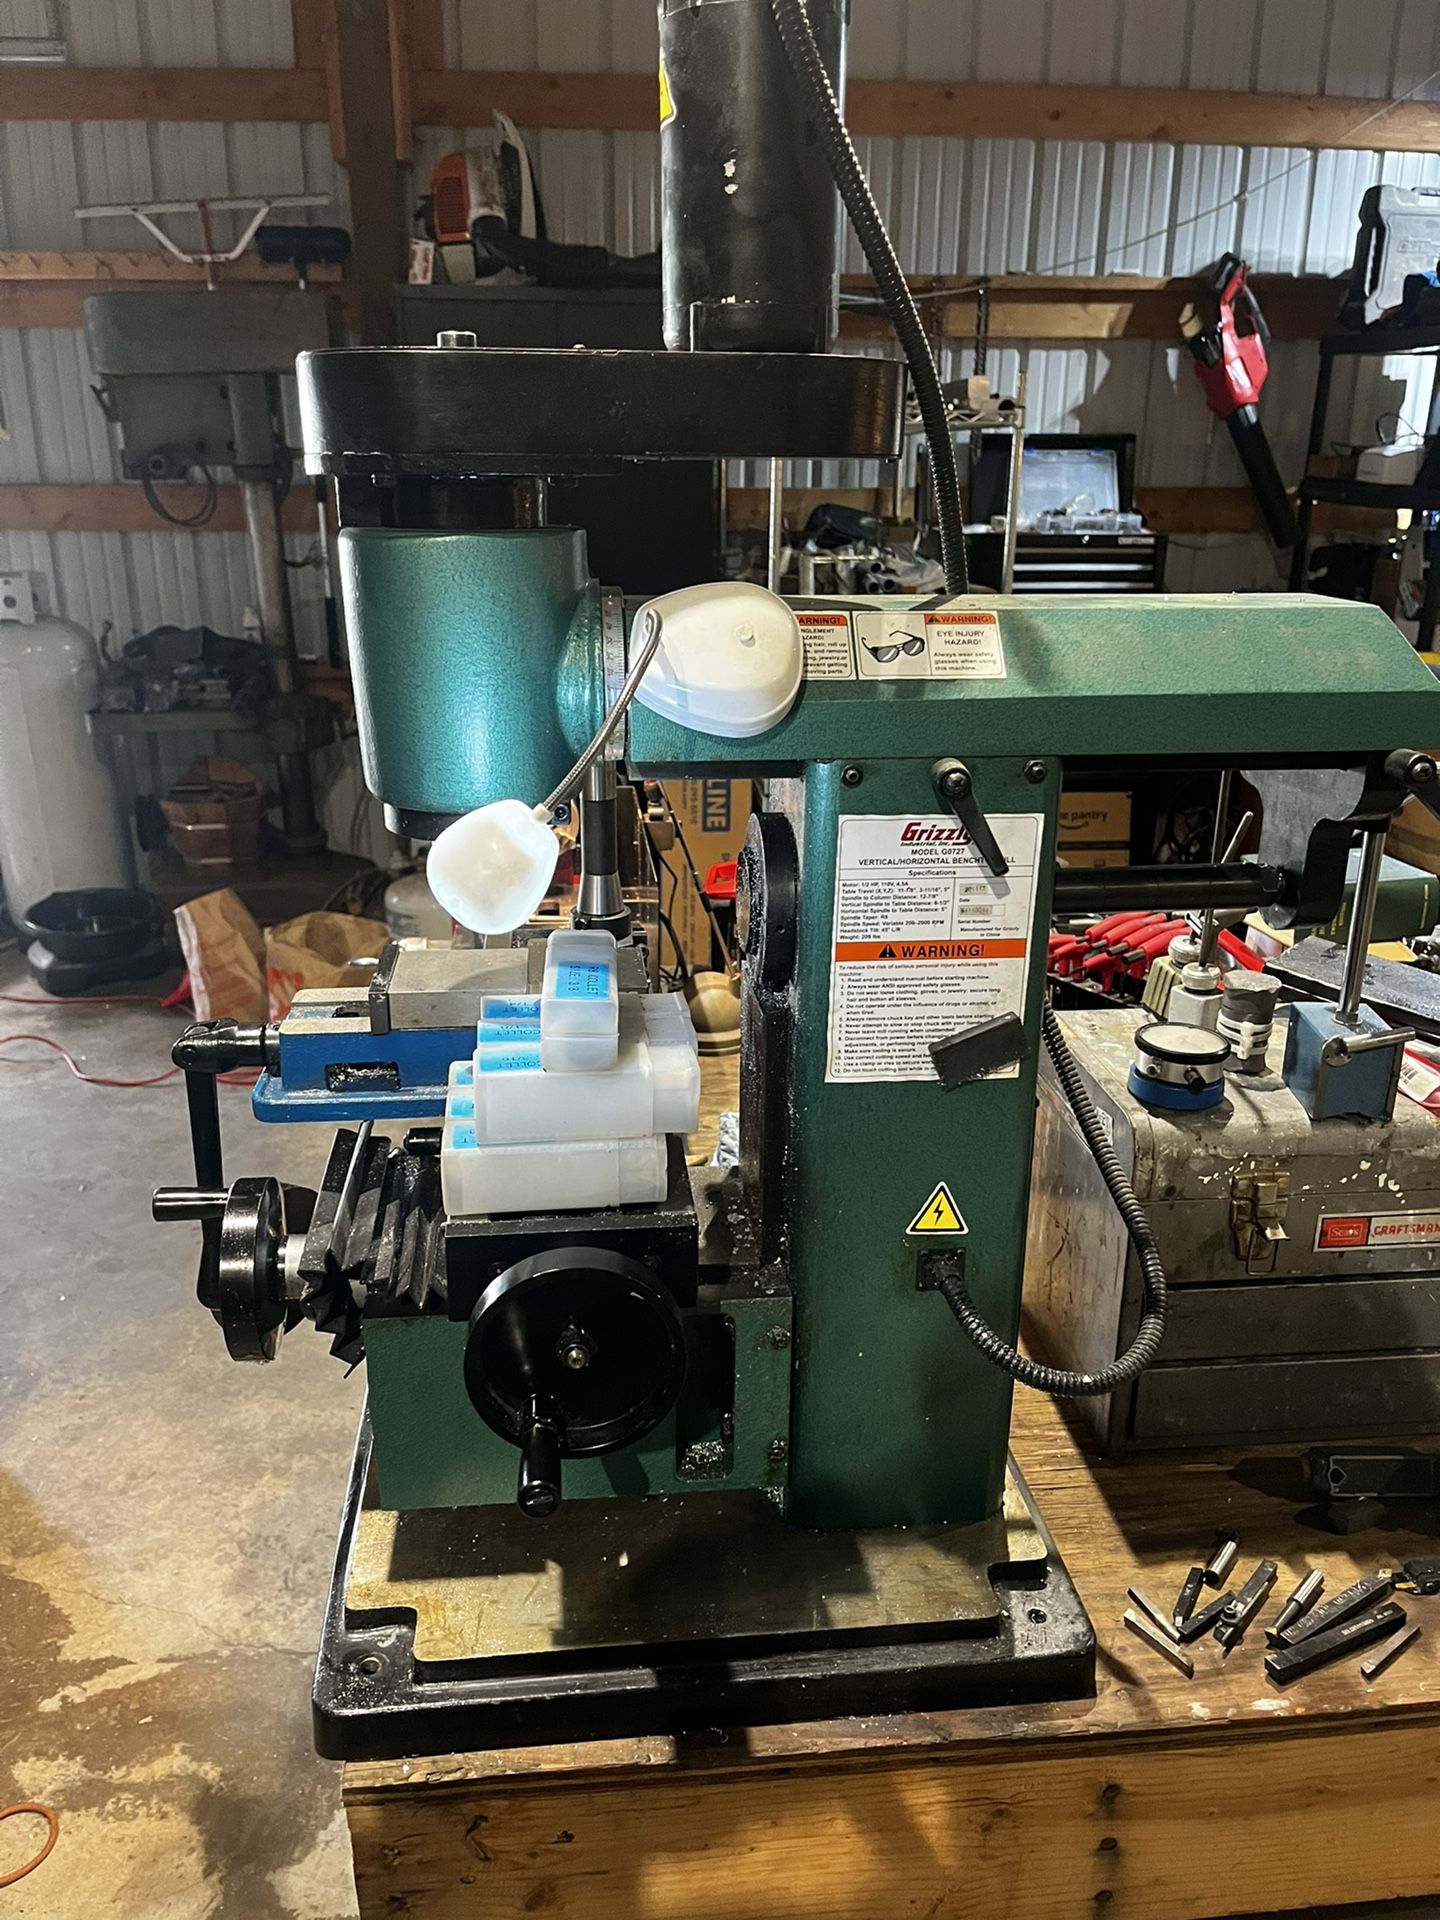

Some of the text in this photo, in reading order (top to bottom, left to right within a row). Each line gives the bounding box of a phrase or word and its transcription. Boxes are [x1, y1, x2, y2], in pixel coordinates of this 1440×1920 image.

[706, 779, 728, 827] LINE
[1071, 811, 1107, 821] pantry
[858, 857, 984, 866] VERTICAL/HORIZONTAL BENCHT
[901, 945, 985, 958] WARNING!
[587, 974, 599, 995] COLLET
[1331, 1227, 1360, 1238] Sears
